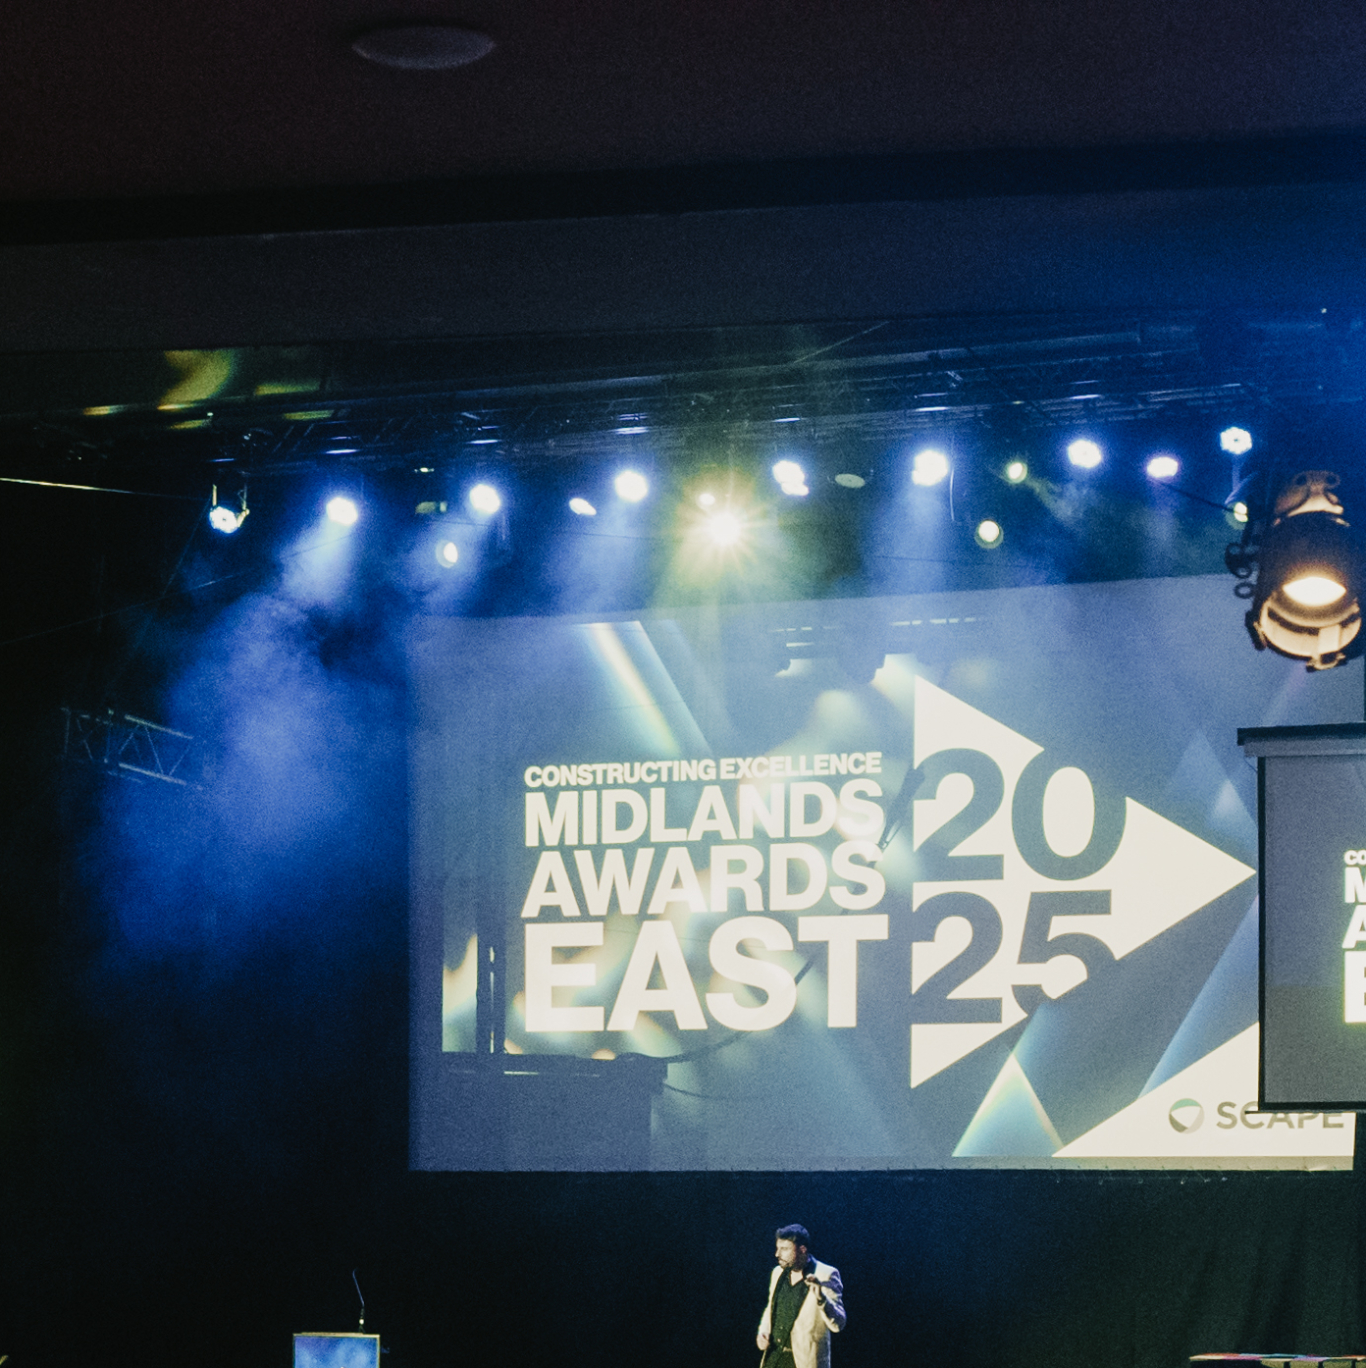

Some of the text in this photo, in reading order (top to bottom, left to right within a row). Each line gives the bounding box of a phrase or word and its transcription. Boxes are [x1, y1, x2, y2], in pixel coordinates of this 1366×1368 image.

[524, 752, 882, 787] CONSTRUCTING EXCELLENCE
[525, 778, 885, 847] MIDLANDS
[913, 747, 1126, 881] 20
[520, 840, 886, 918] AWARDS
[525, 914, 889, 1032] EAST
[911, 889, 1117, 1024] 25
